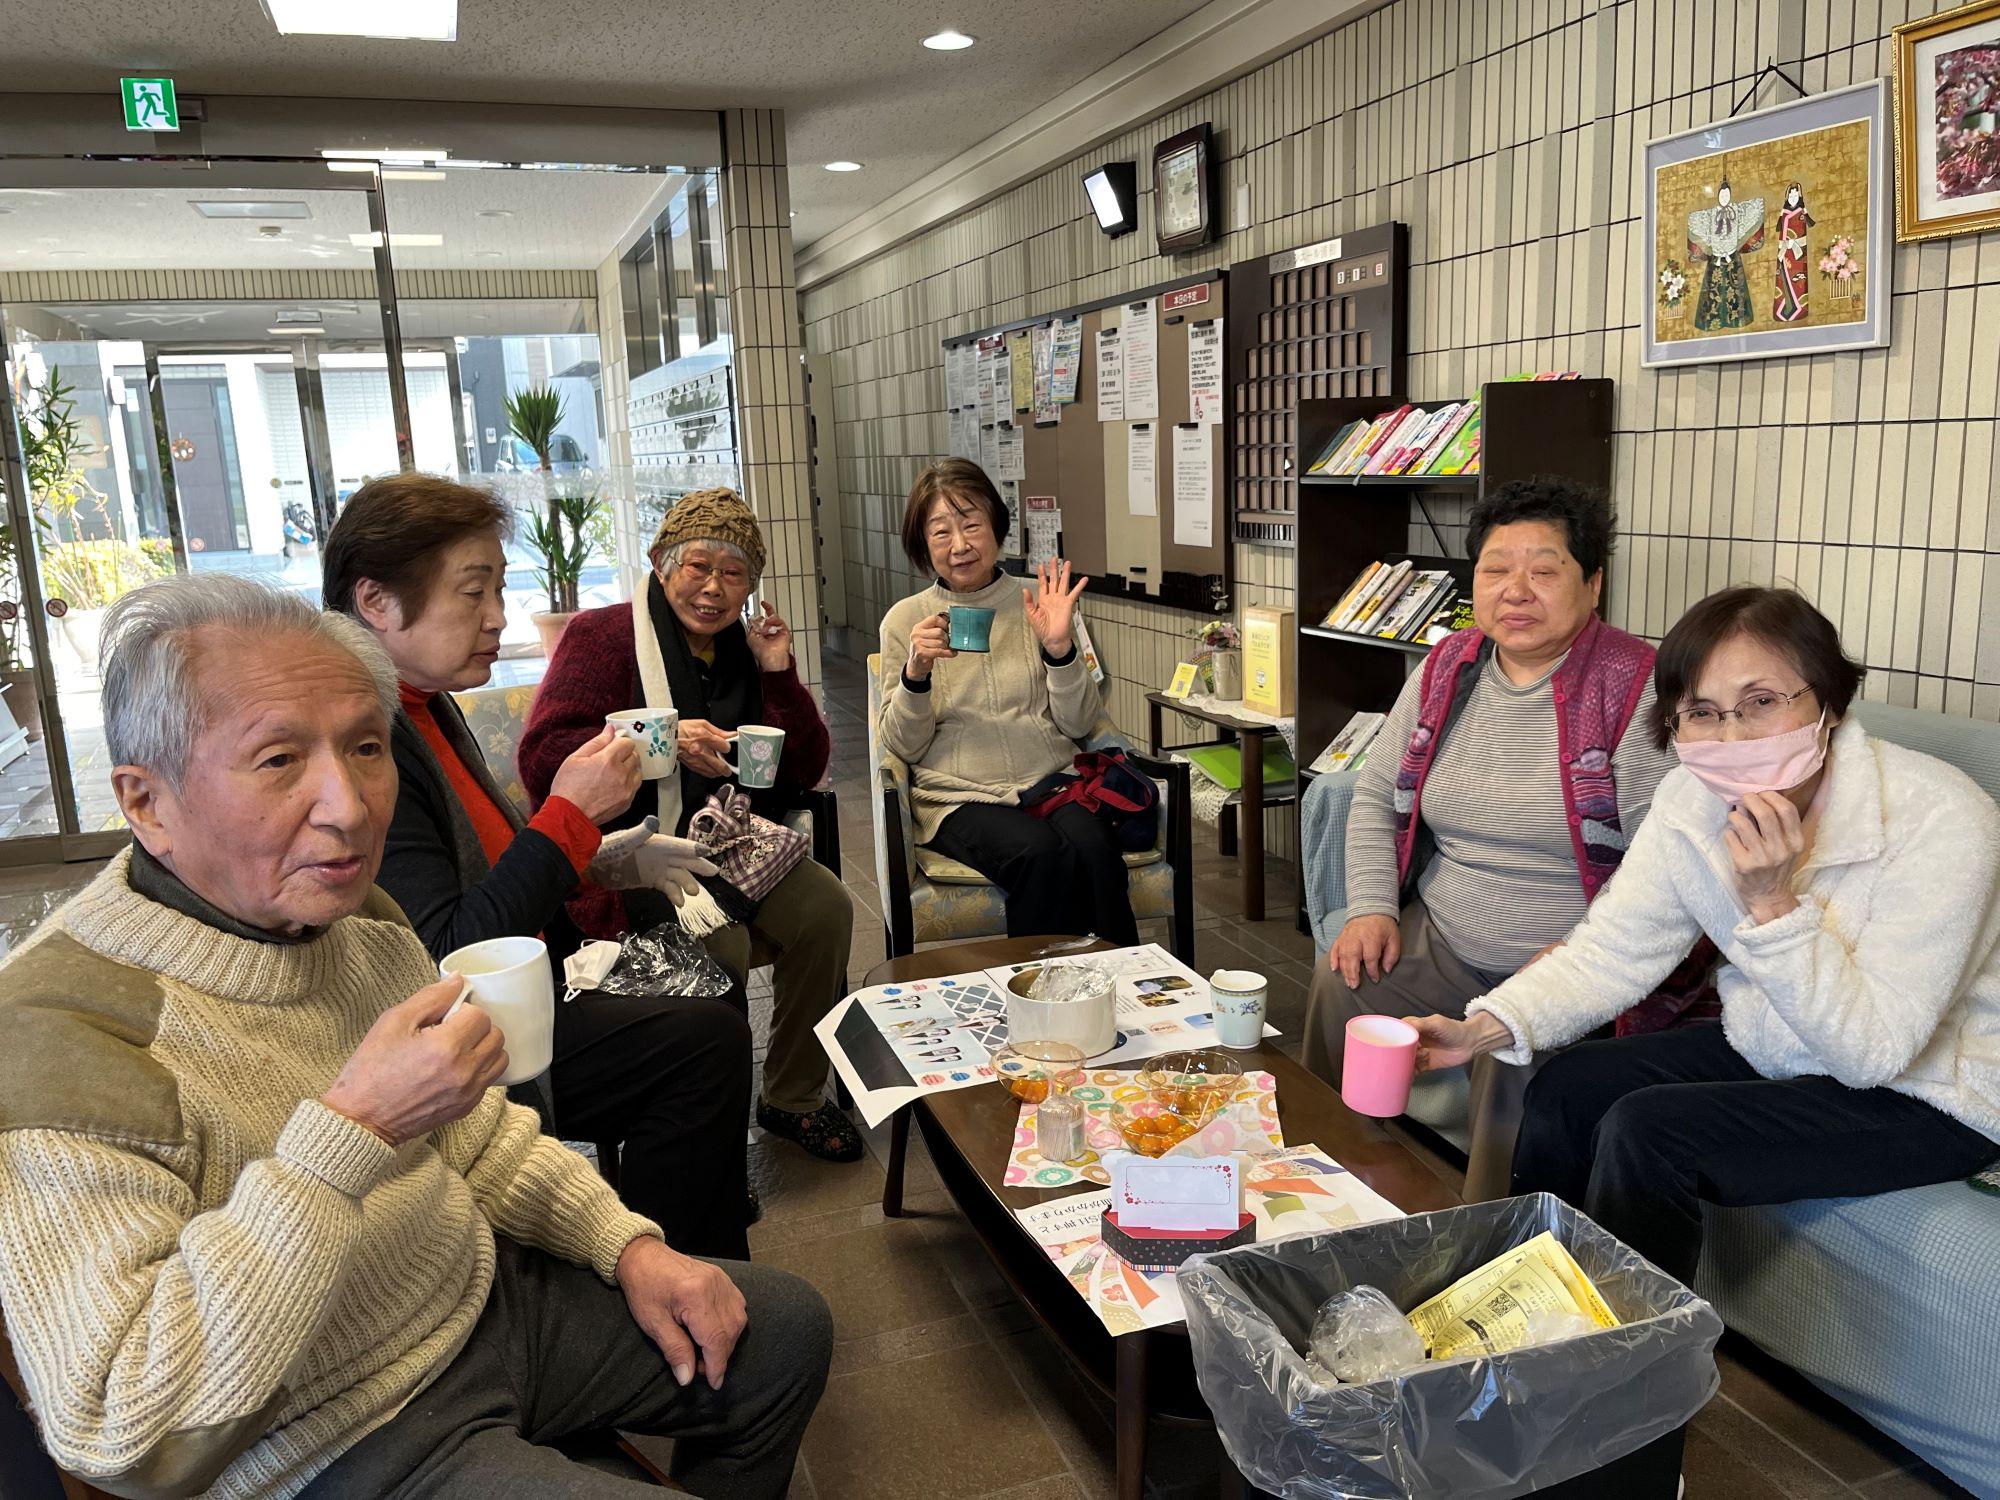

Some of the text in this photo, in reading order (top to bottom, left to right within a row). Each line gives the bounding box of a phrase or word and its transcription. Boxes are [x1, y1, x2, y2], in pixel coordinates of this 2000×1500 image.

[1173, 291, 1198, 306] 本日の予定
